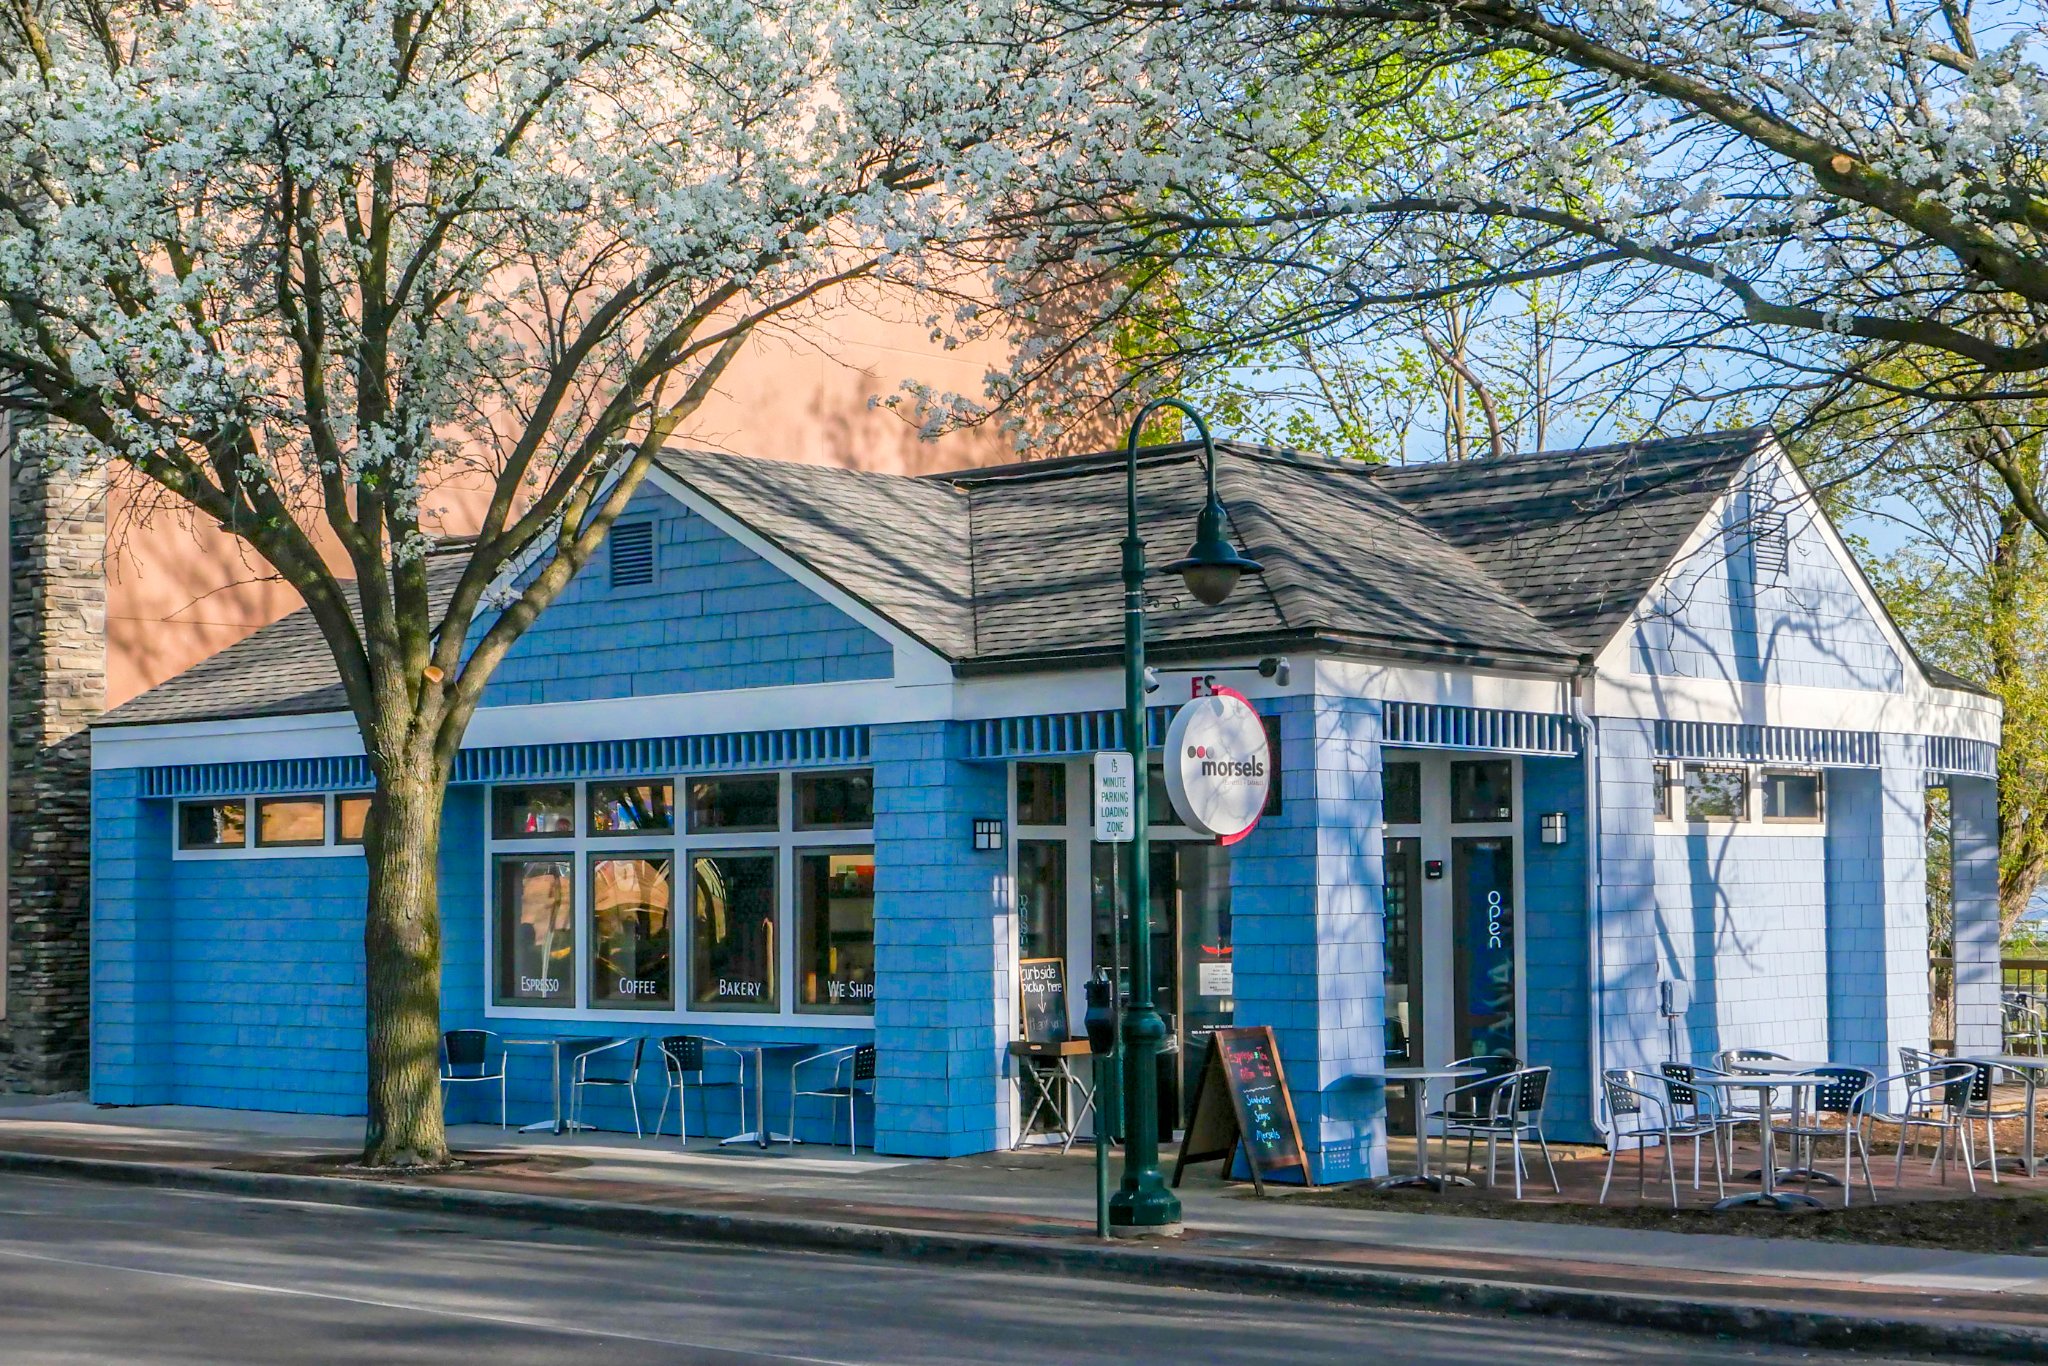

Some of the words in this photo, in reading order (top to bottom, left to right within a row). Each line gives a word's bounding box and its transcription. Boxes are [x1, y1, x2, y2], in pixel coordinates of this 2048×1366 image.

[1111, 761, 1118, 773] 15
[1202, 755, 1264, 777] morsels
[1102, 777, 1127, 788] MINUTE
[1101, 792, 1128, 803] PARKING
[1101, 807, 1128, 818] LOADING
[1106, 821, 1124, 832] ZONE
[1021, 964, 1056, 981] curbside
[1022, 981, 1045, 996] pickup
[1047, 980, 1063, 993] here
